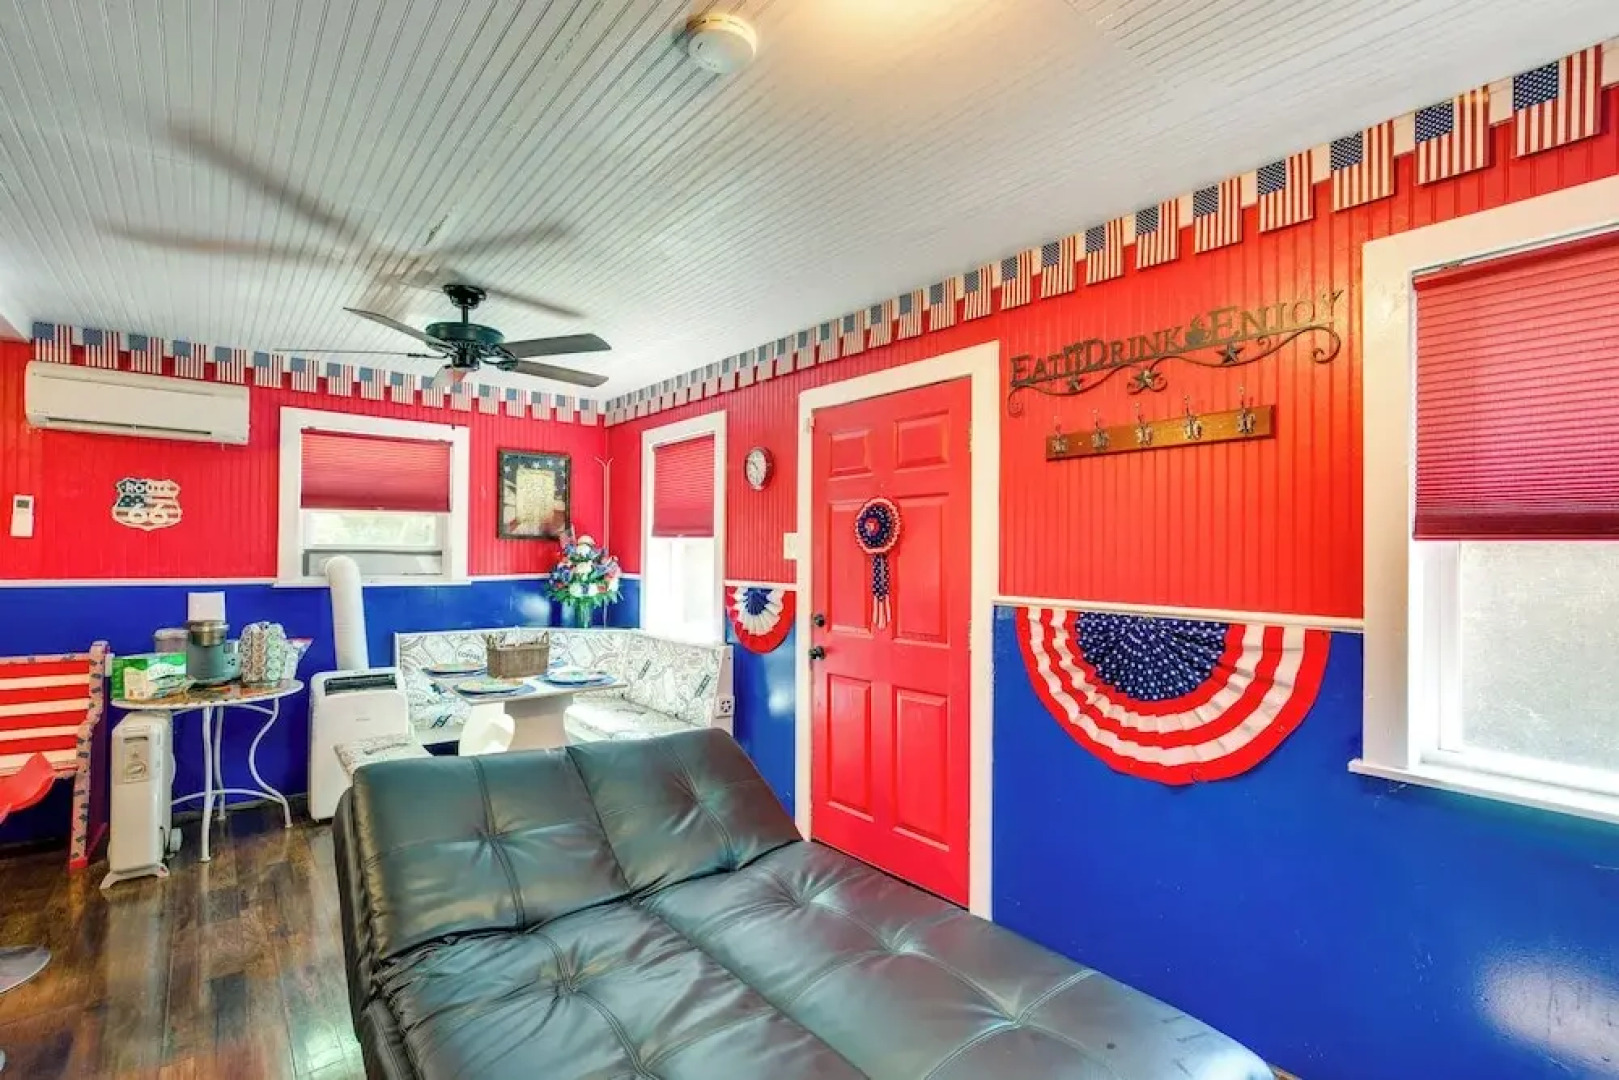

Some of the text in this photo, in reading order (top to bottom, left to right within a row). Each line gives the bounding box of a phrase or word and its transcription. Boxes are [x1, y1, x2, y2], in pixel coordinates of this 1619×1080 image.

[1011, 289, 1344, 384] EAT DRINK ENJOY
